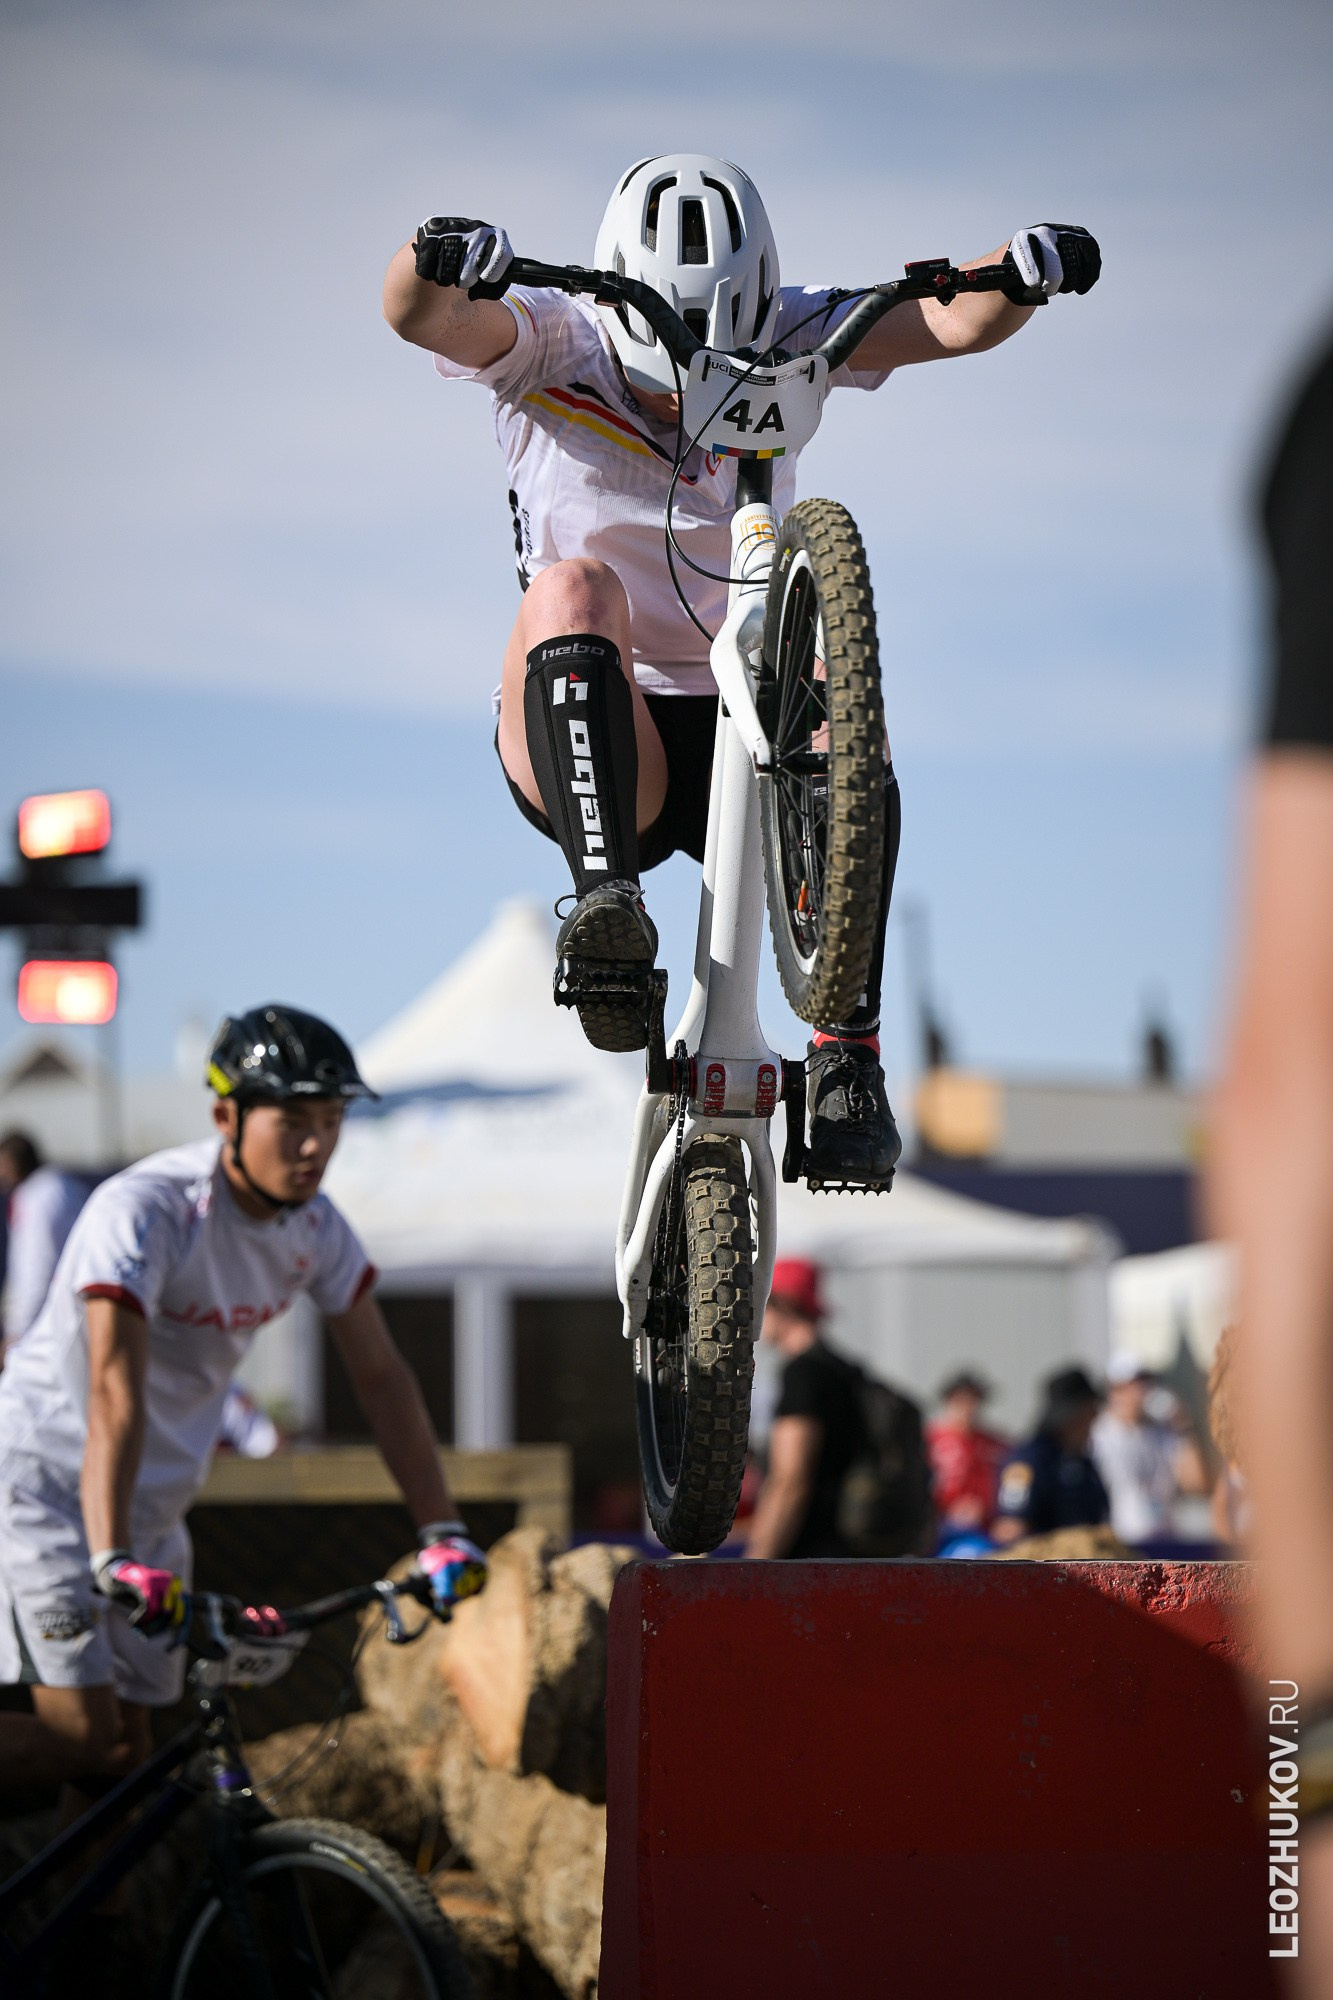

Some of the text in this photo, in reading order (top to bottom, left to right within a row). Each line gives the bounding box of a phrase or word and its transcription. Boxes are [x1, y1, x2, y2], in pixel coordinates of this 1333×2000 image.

[711, 361, 729, 373] UCI
[722, 398, 785, 434] 4A
[751, 522, 775, 541] 10
[541, 642, 606, 662] hebo
[568, 719, 608, 871] hebo
